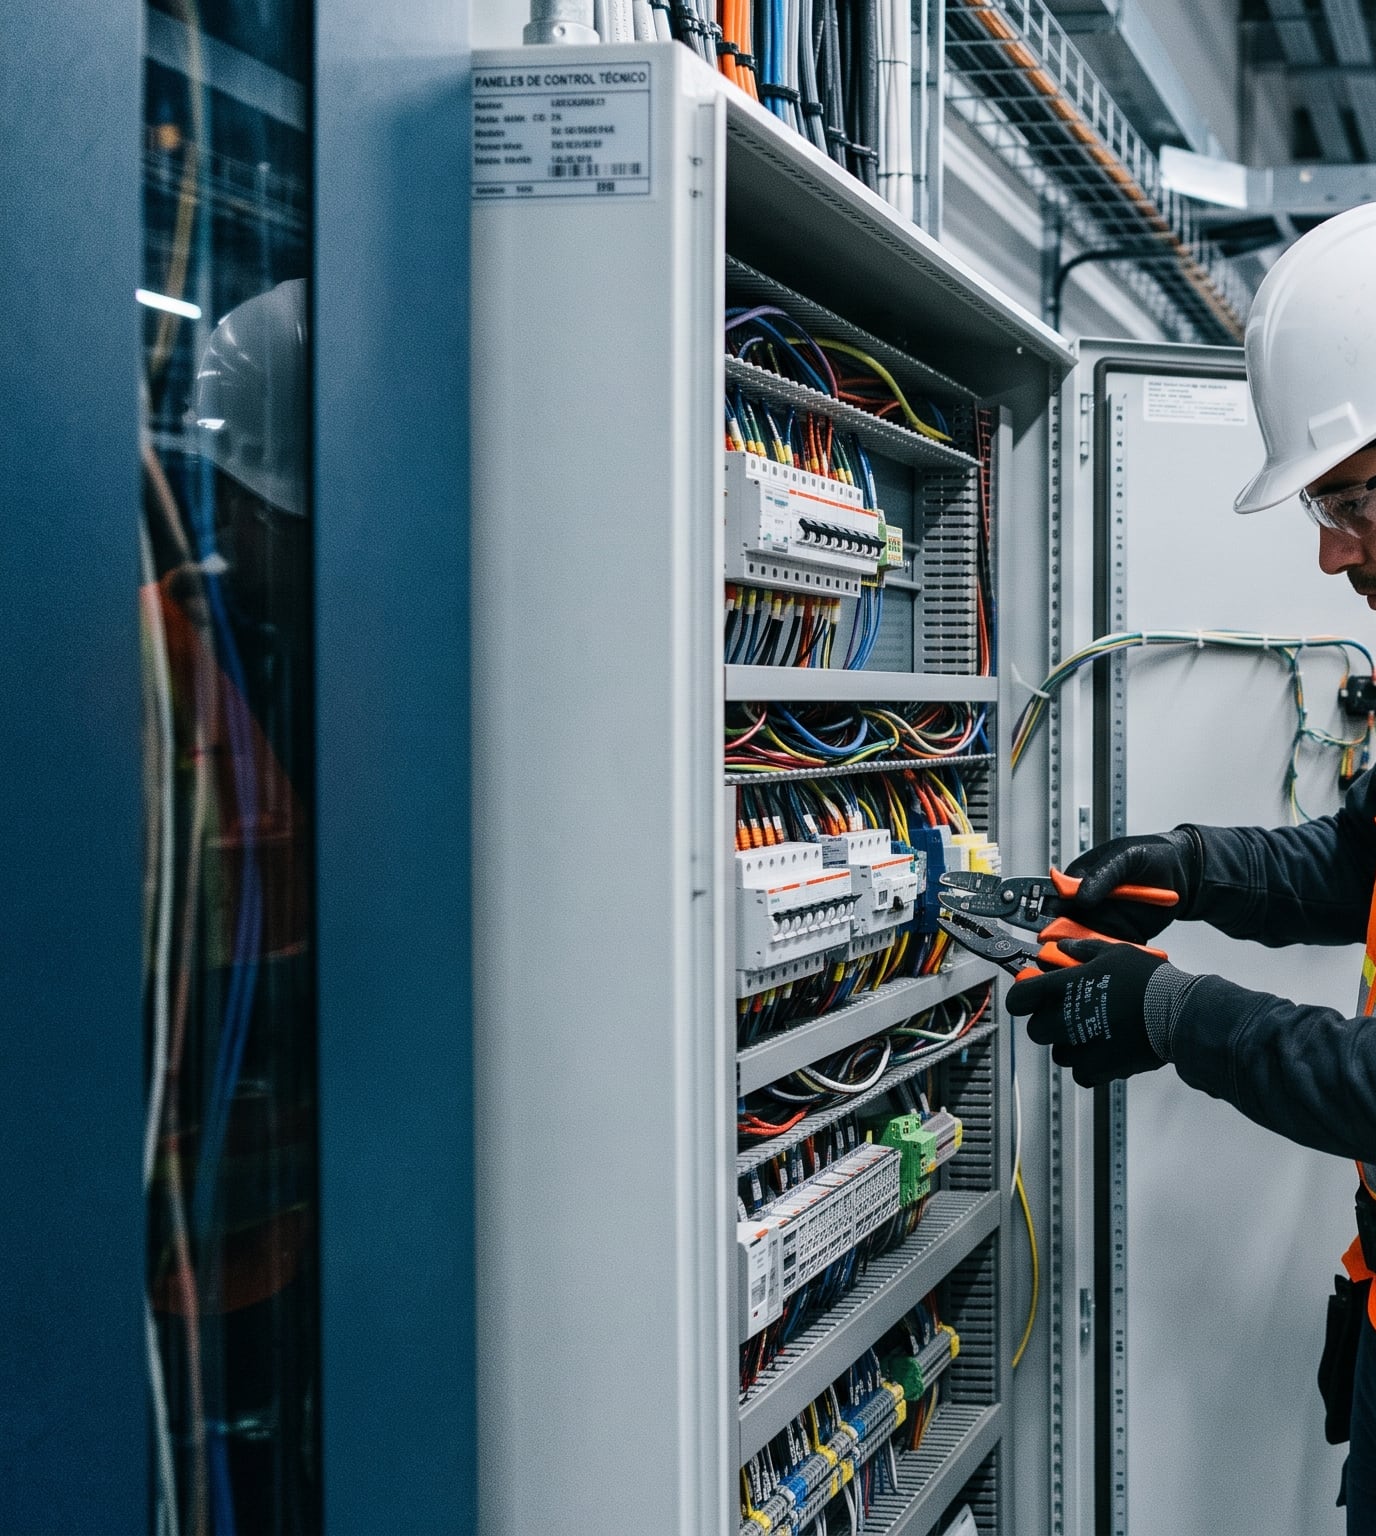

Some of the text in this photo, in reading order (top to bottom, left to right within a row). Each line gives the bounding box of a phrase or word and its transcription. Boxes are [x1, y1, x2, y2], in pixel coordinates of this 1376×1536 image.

[475, 71, 647, 88] PANELES DE CONTROL TÉCNICO
